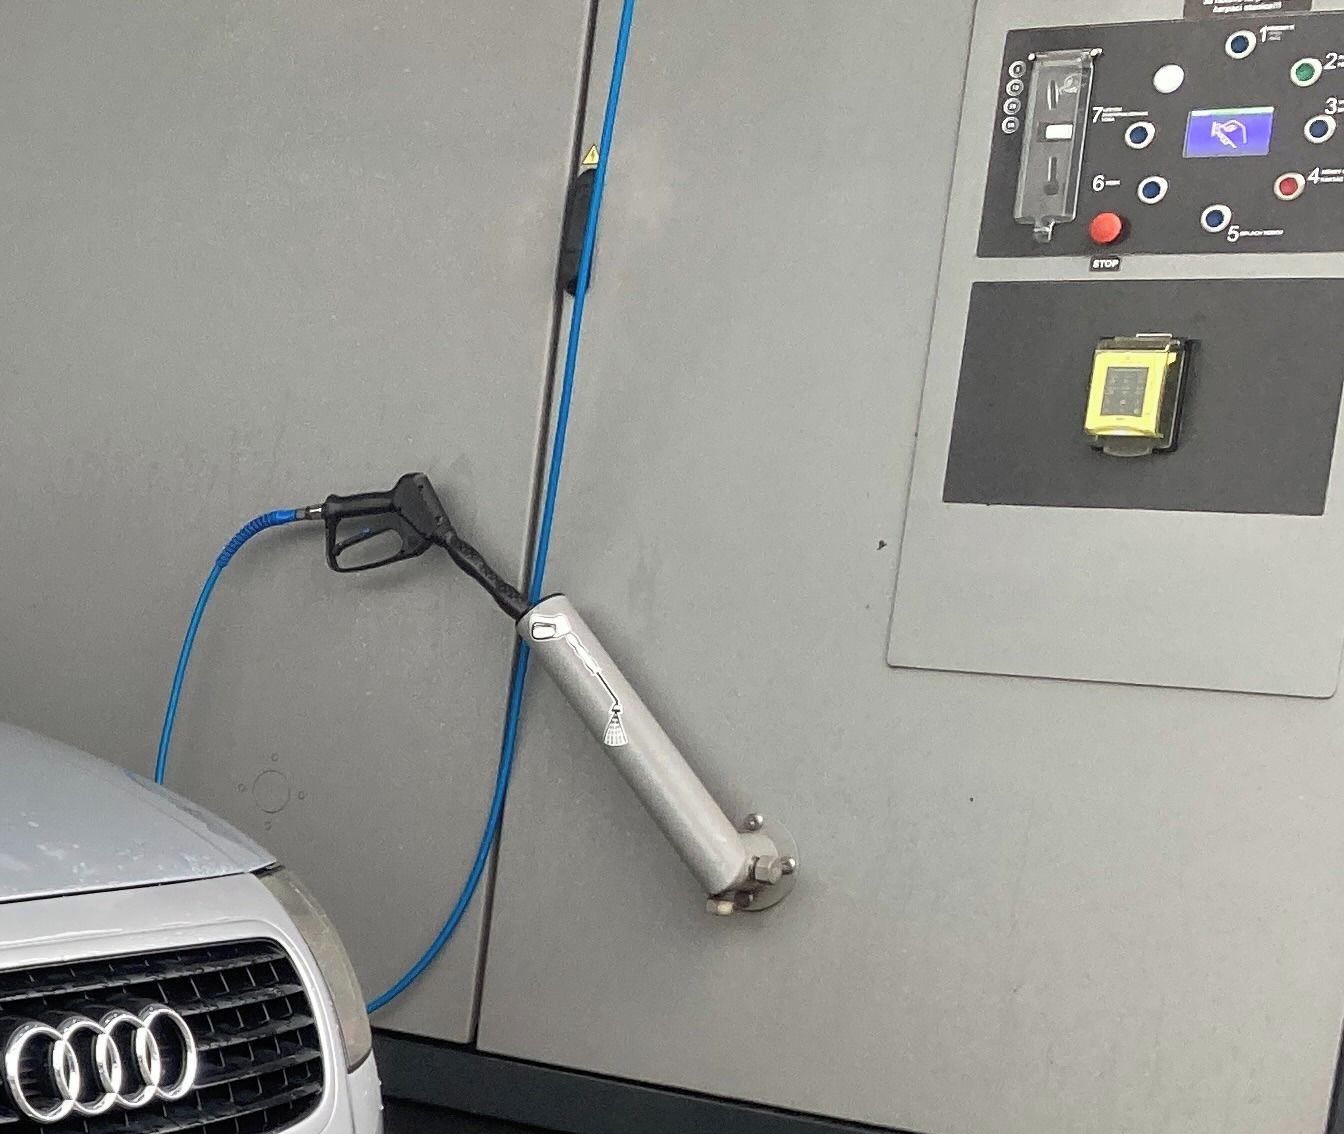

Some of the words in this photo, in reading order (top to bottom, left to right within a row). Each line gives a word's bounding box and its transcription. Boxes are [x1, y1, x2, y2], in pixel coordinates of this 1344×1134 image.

[1323, 52, 1338, 70] 2
[1092, 107, 1104, 123] 7
[1324, 97, 1338, 115] 3
[1092, 174, 1105, 192] 6
[1306, 166, 1321, 185] 4
[1226, 225, 1240, 243] 5
[1092, 258, 1120, 270] STOP
